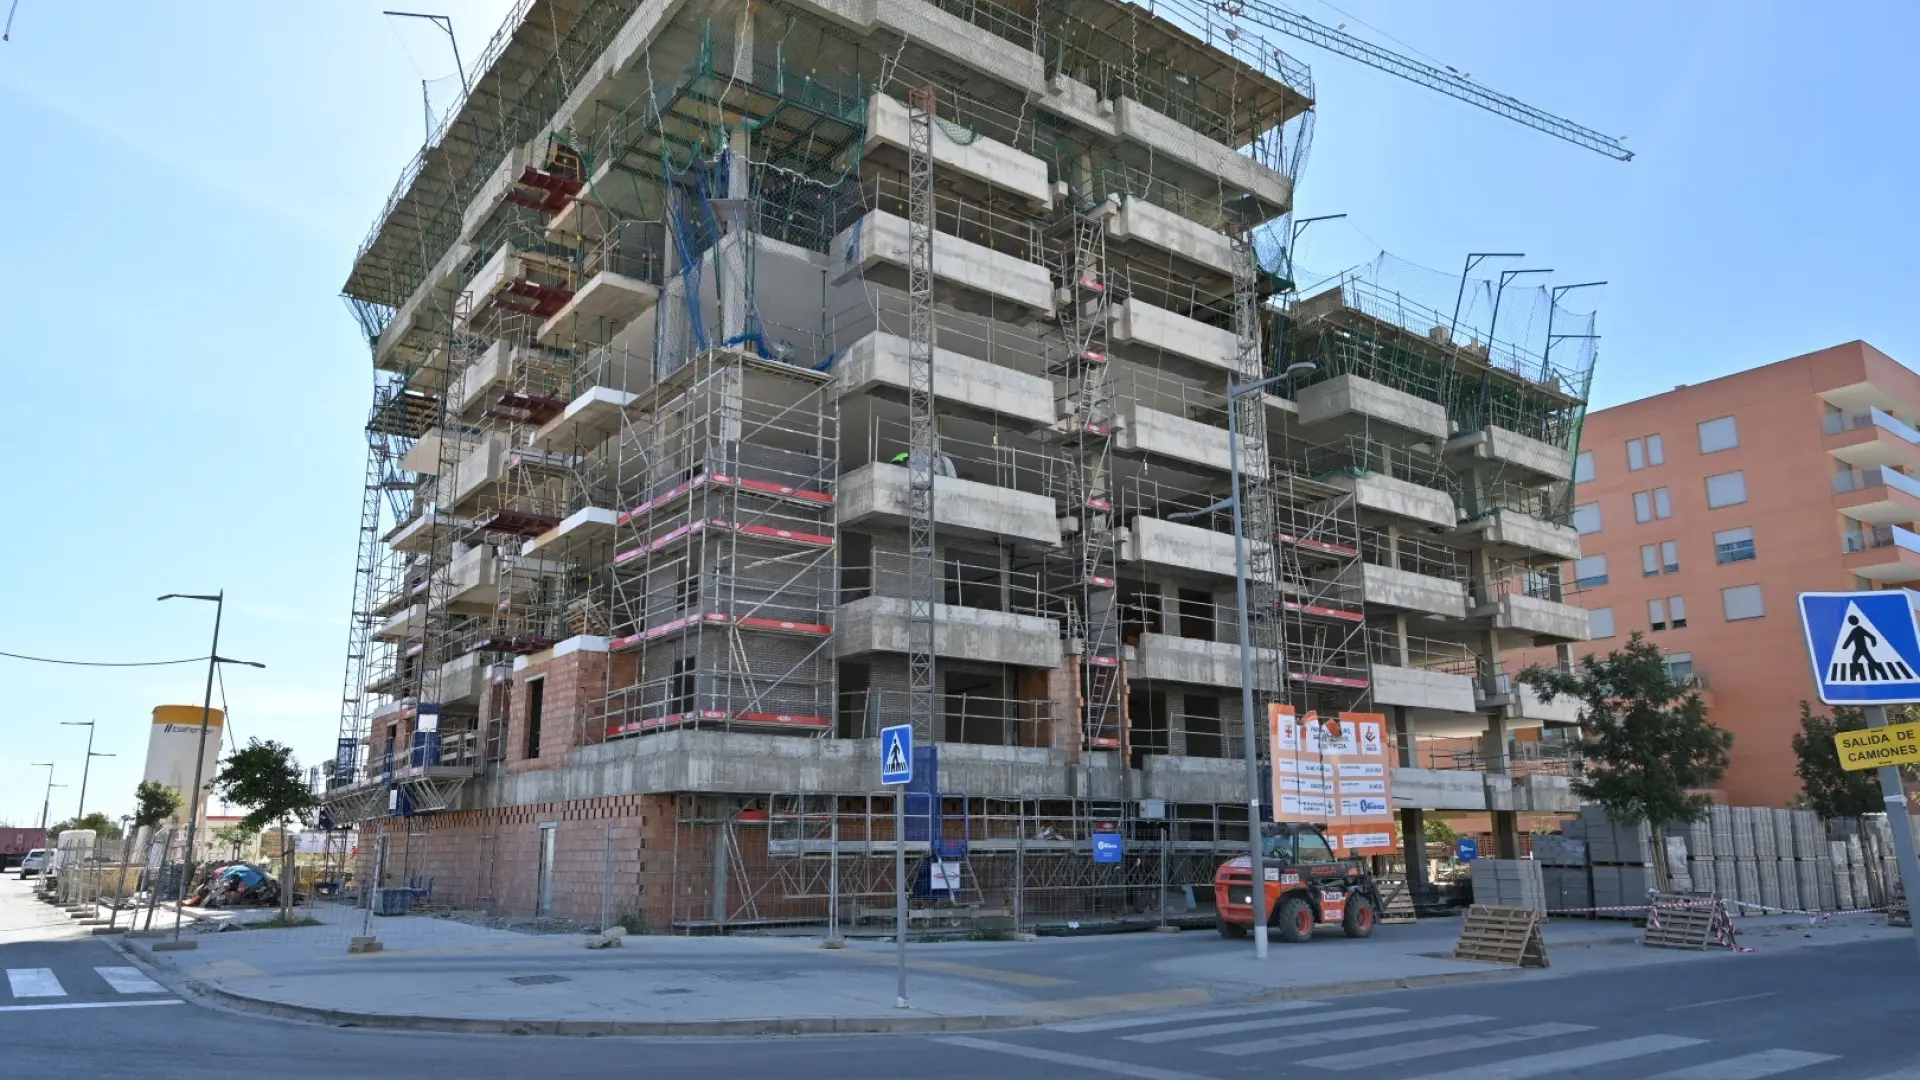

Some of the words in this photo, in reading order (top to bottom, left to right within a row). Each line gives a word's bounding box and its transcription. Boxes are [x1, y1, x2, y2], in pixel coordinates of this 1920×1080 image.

[1842, 733, 1890, 748] SALIDA
[1896, 730, 1916, 741] DE
[1848, 744, 1918, 762] CAMIONES
